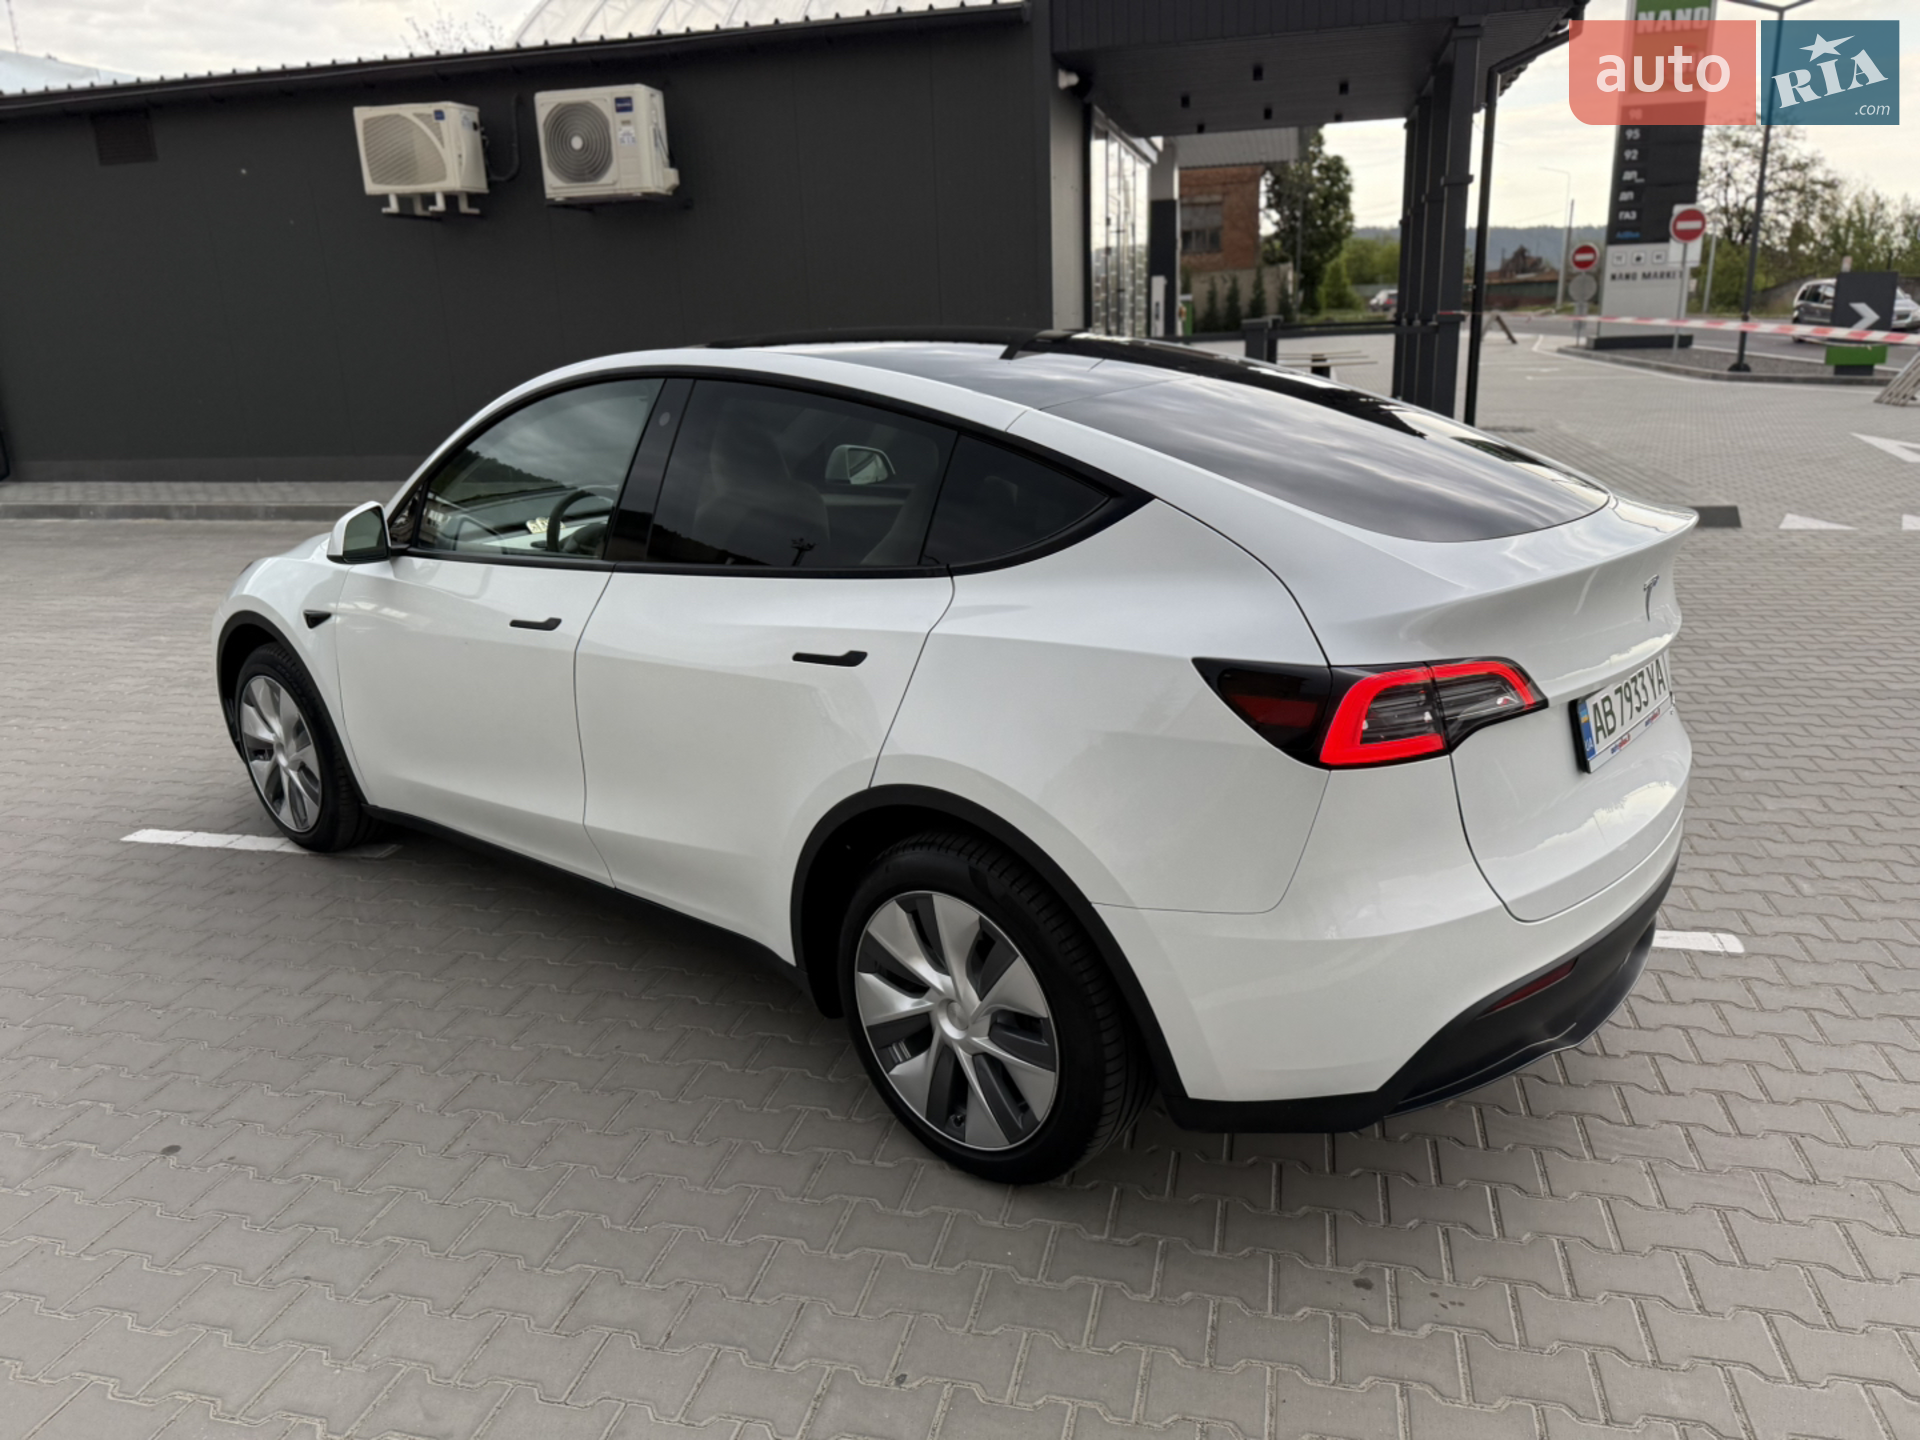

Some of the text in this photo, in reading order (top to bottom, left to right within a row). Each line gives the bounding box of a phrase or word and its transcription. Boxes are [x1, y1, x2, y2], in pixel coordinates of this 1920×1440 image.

[1637, 6, 1710, 34] NANO
[1625, 128, 1641, 140] 95
[1623, 148, 1638, 161] 92
[1618, 210, 1637, 221] ГАЗ
[1592, 695, 1617, 744] AB
[1614, 671, 1649, 726] 7933
[1645, 658, 1666, 700] YA
